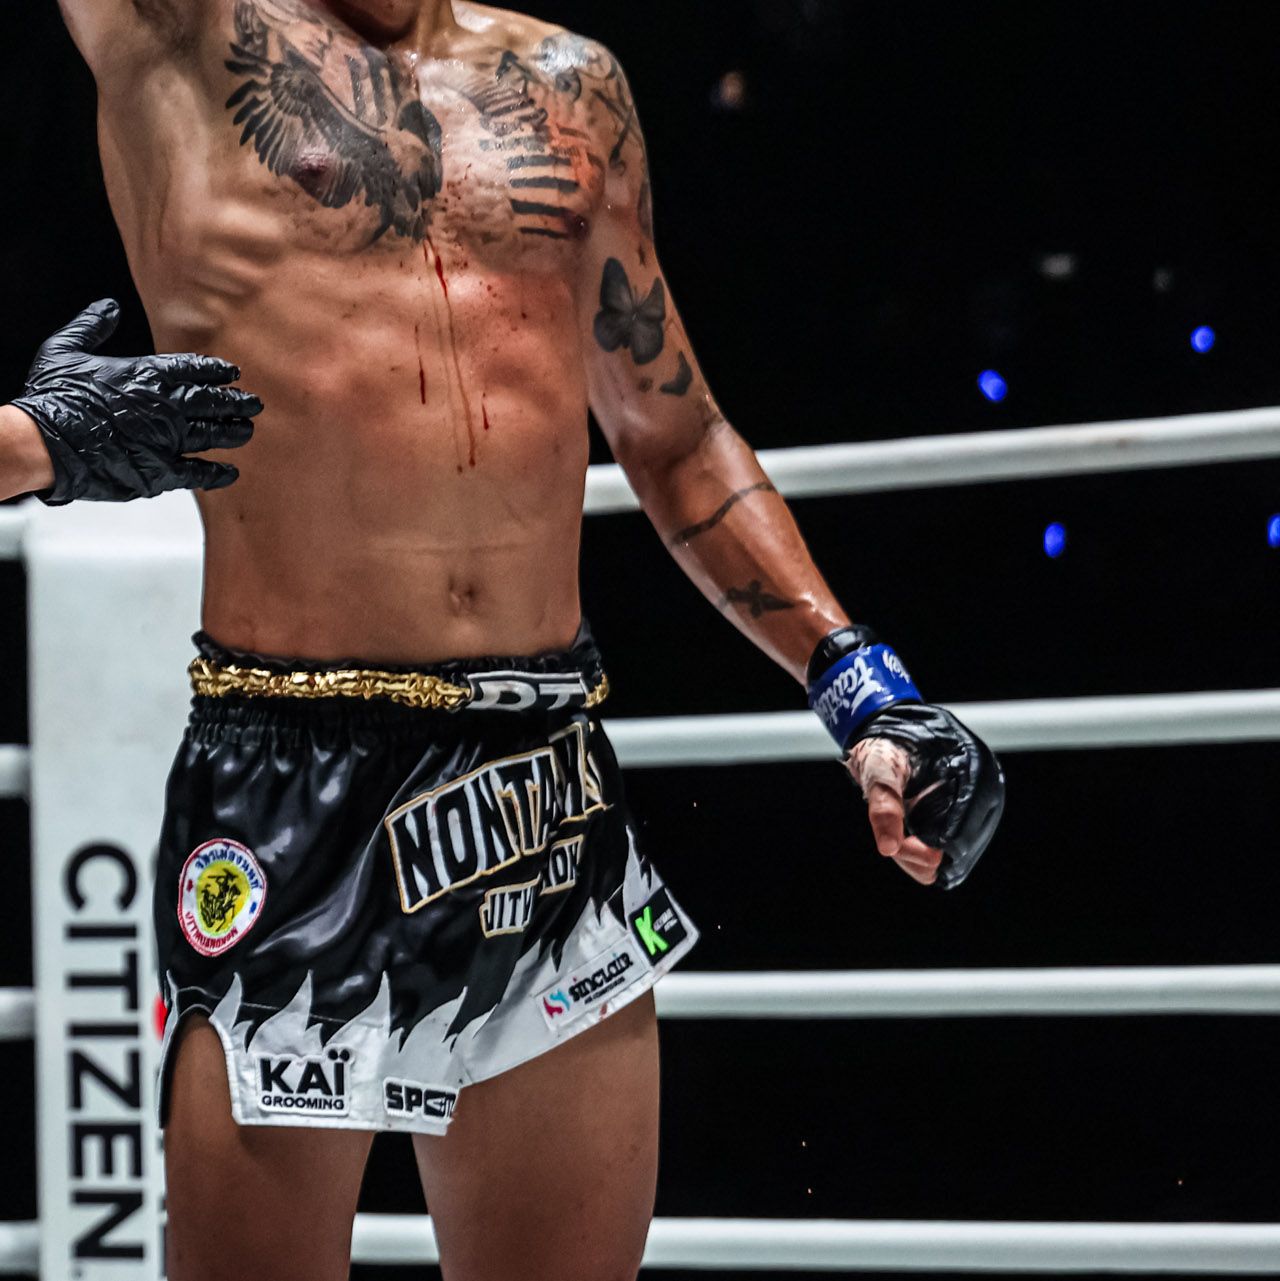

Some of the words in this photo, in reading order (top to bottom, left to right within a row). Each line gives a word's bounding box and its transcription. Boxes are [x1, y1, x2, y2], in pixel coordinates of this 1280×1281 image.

[62, 839, 146, 1261] CITIZEN
[259, 1048, 351, 1096] KAÏ
[260, 1094, 345, 1111] GROOMING
